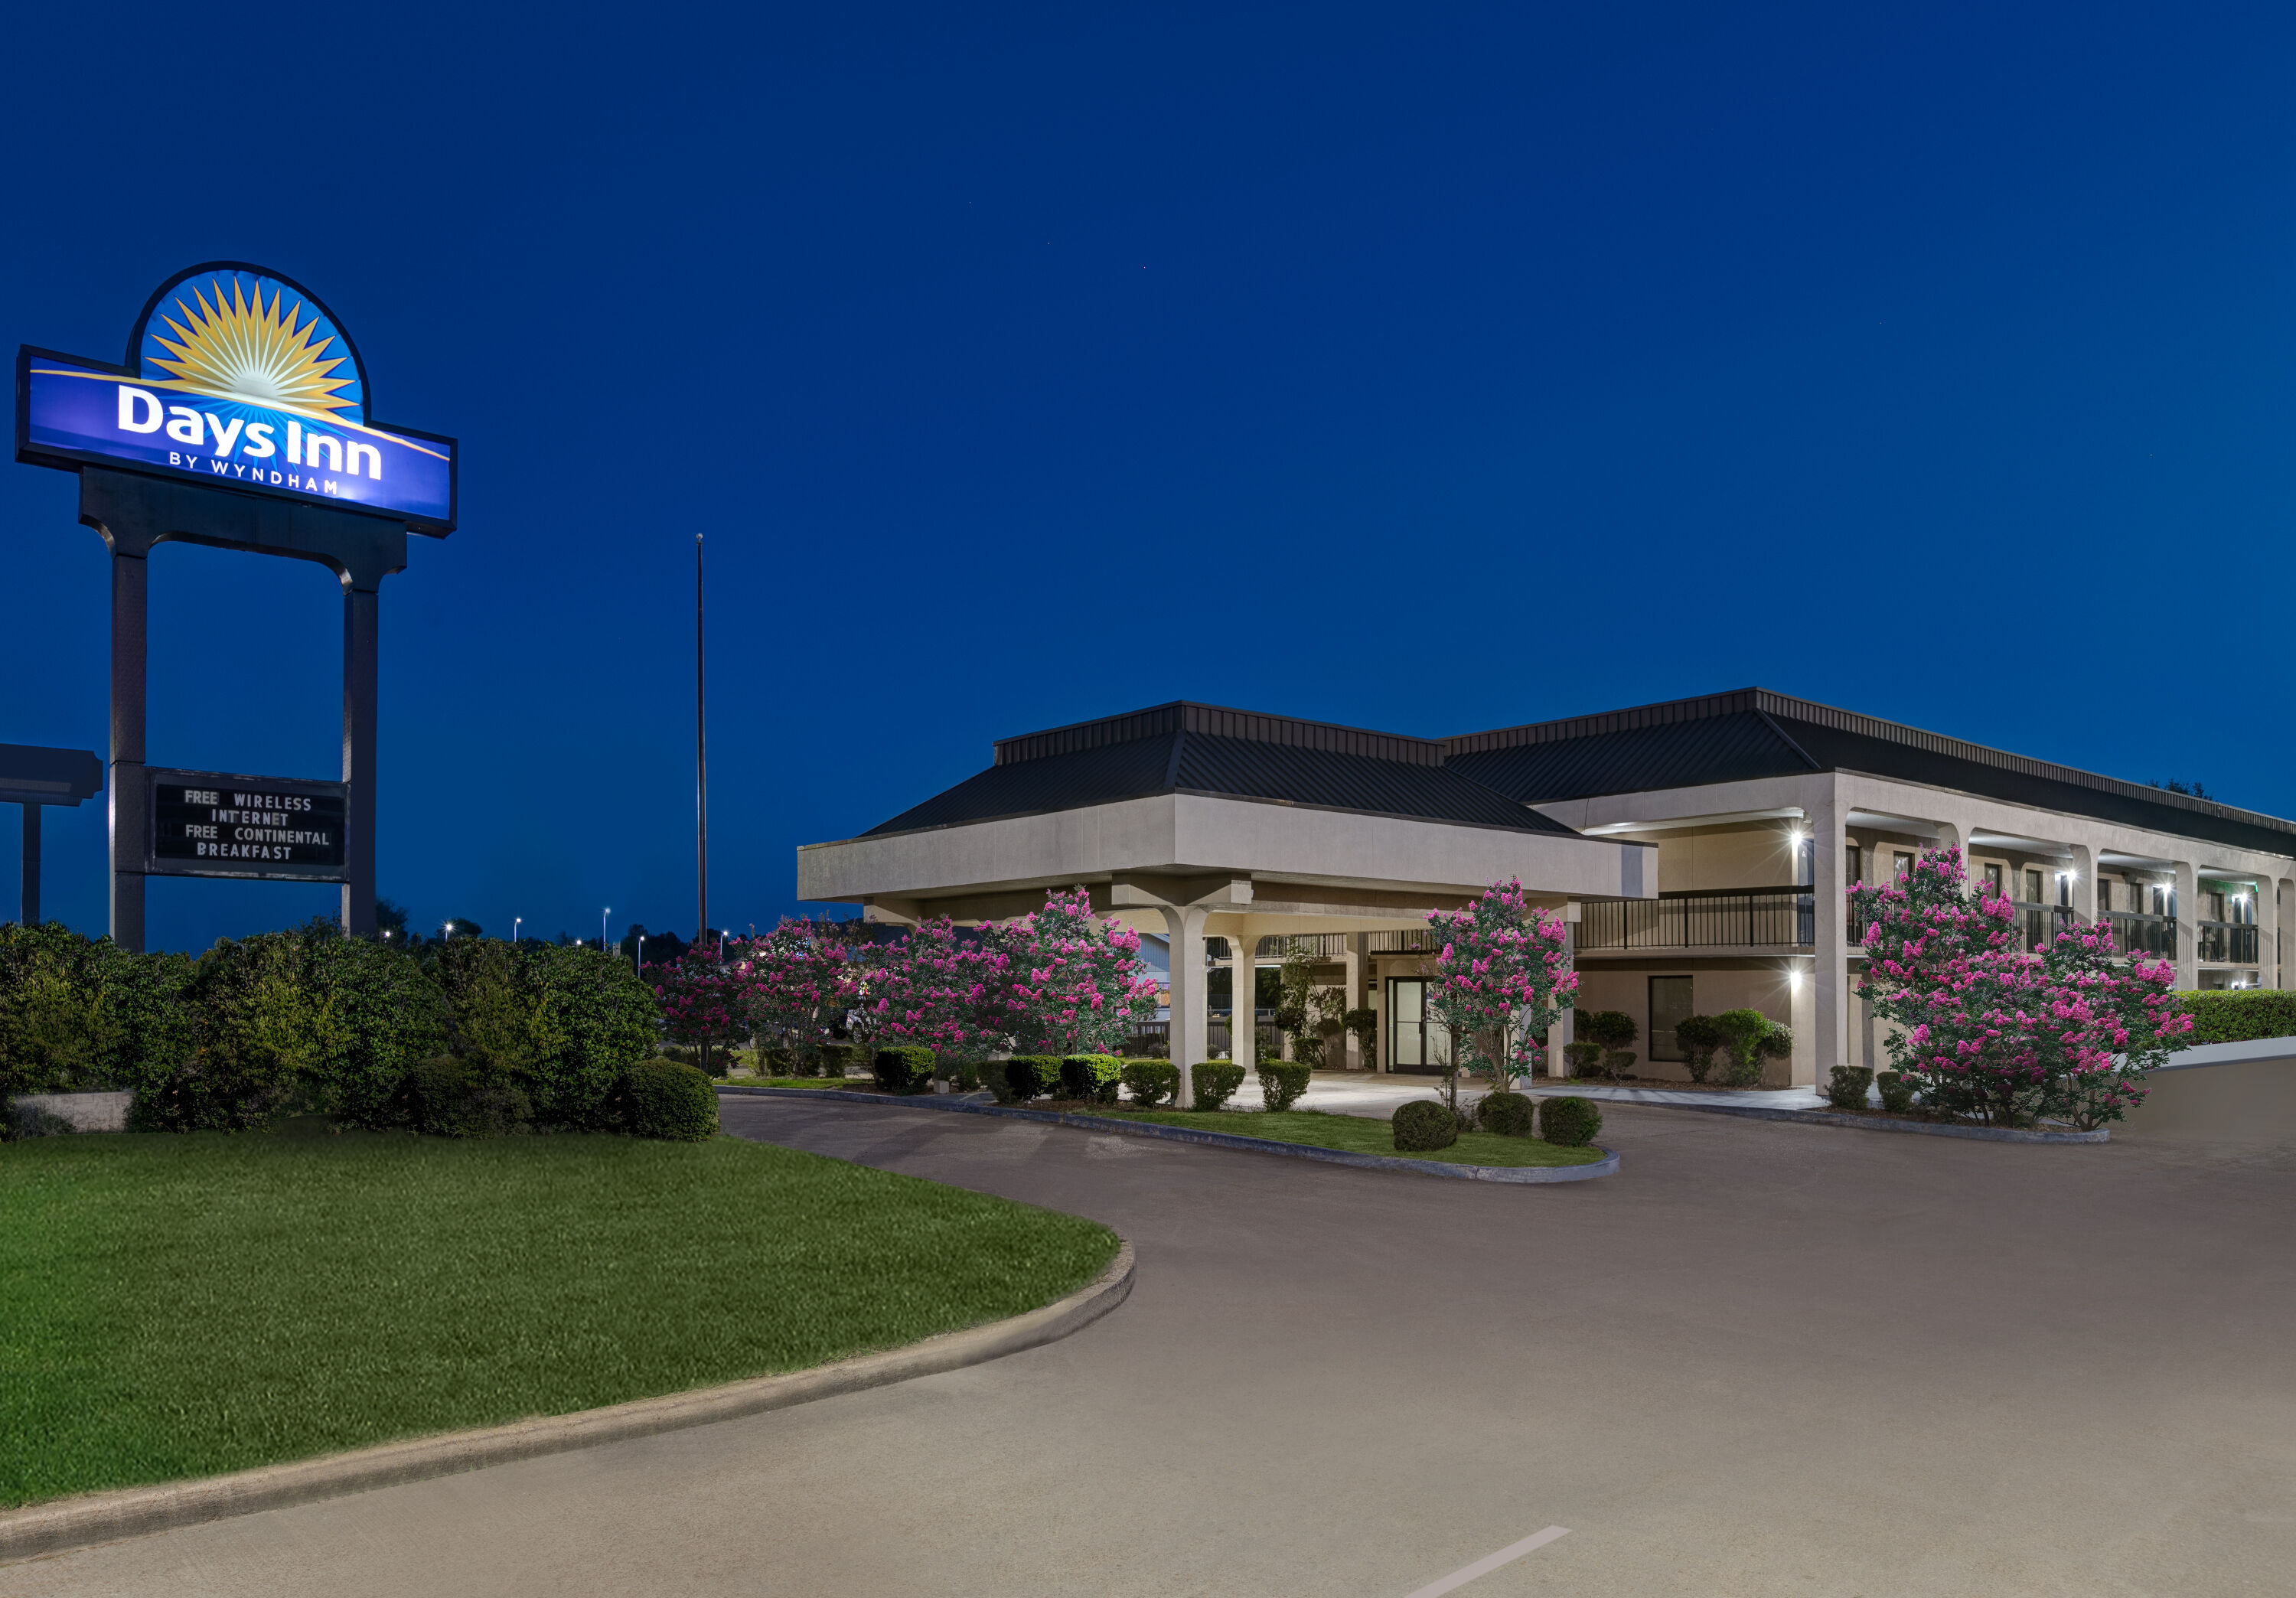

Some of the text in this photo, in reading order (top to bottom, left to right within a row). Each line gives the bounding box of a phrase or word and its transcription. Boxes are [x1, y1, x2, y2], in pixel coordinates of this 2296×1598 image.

[119, 385, 381, 480] Days Inn
[169, 452, 338, 495] BY WYNDHAM
[185, 790, 311, 811] FREE WIRELESS
[212, 808, 288, 827] INTERNET
[186, 824, 329, 846] FREE CONTINENTAL
[197, 842, 291, 859] BREAKFAST
